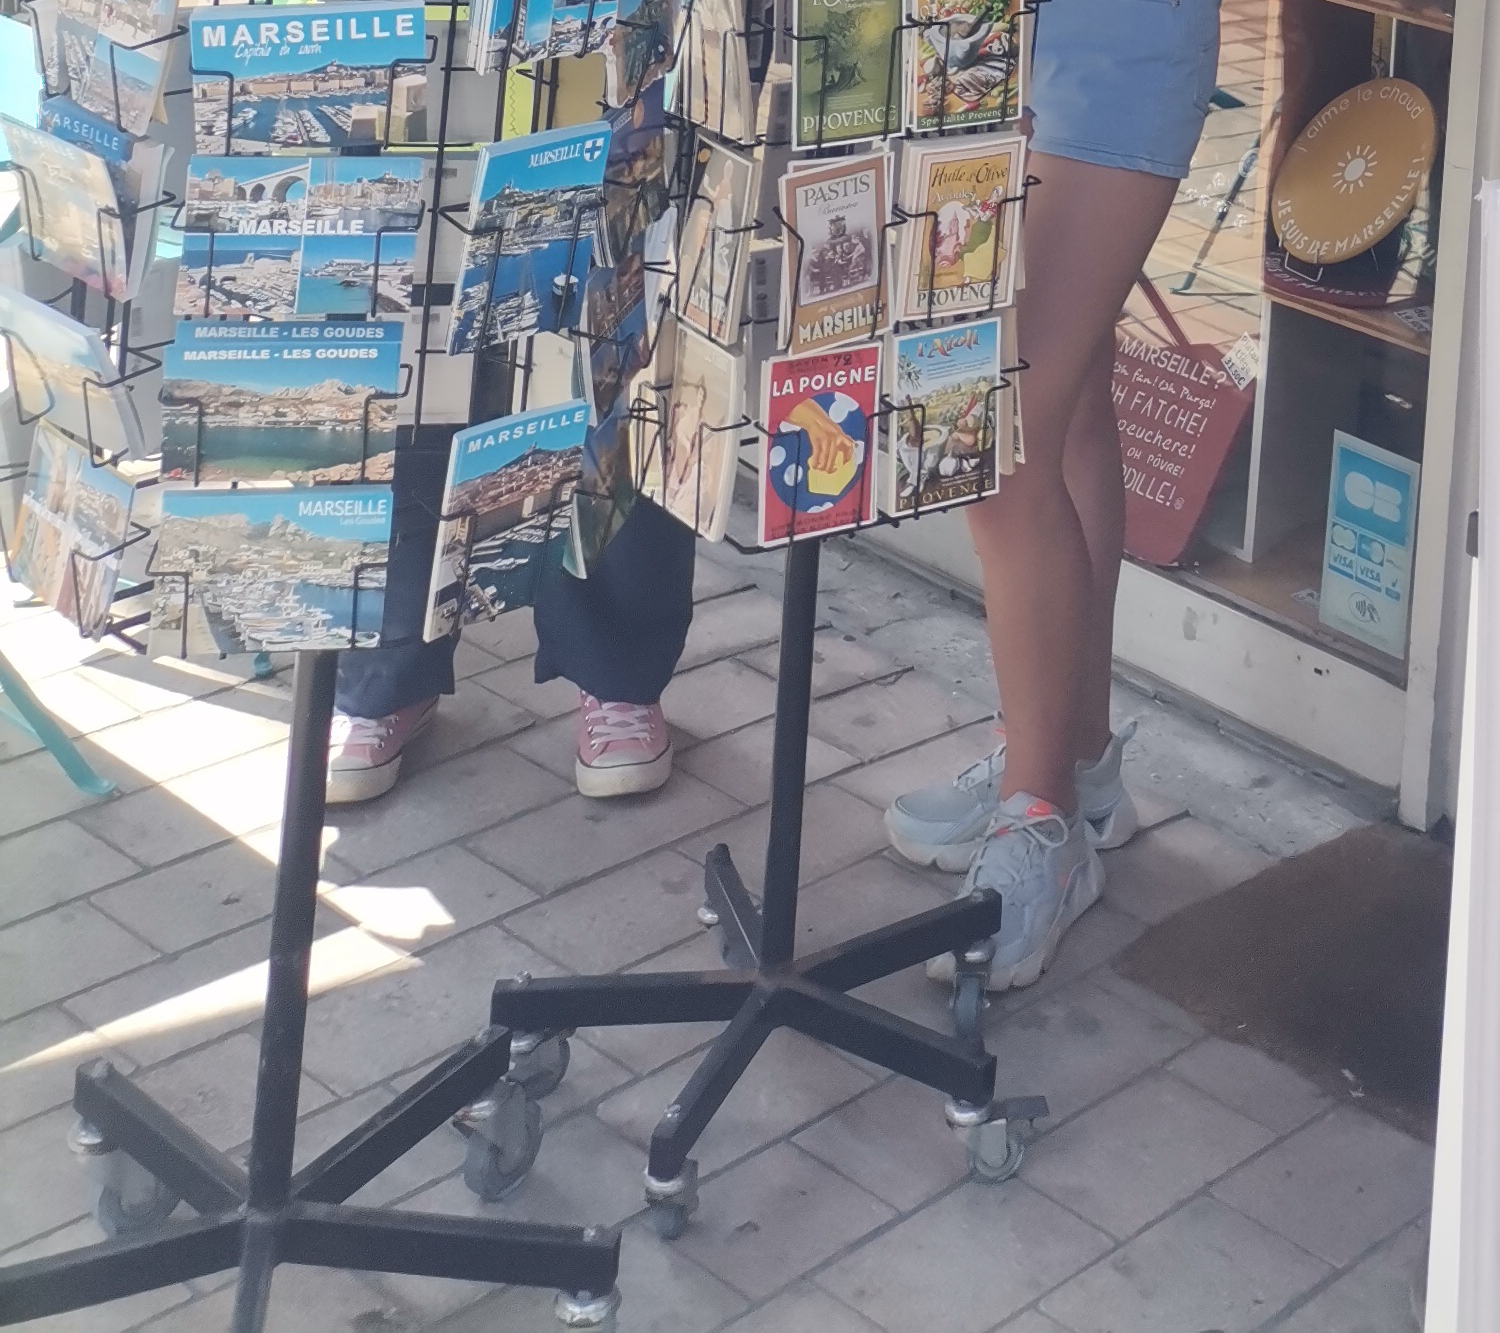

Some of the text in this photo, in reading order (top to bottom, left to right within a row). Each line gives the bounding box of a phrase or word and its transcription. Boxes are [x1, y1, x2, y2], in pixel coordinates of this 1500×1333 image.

[203, 13, 415, 49] MARSEILLE
[802, 104, 897, 134] PROVENCE
[1357, 84, 1425, 121] le chaud
[529, 145, 582, 169] MARSEILLE
[803, 174, 871, 207] PASTIS
[931, 164, 966, 188] Huile
[238, 219, 365, 235] MARSEILLE
[1277, 199, 1331, 257] JE SUIS DE
[916, 283, 999, 308] PROVENCE
[194, 326, 385, 339] MARSEILLE LES GOUDES
[799, 299, 884, 345] MARSEILLE
[183, 348, 379, 361] MARSEILLE LES GOUDES
[1118, 335, 1212, 386] MARSEILLE
[772, 365, 877, 398] LA POIGNE
[1129, 390, 1209, 438] FATCHE!
[467, 409, 585, 454] MARSEILLE
[298, 499, 388, 517] MARSEILLE
[1344, 470, 1402, 523] CB
[1333, 552, 1382, 583] VISA VISA
